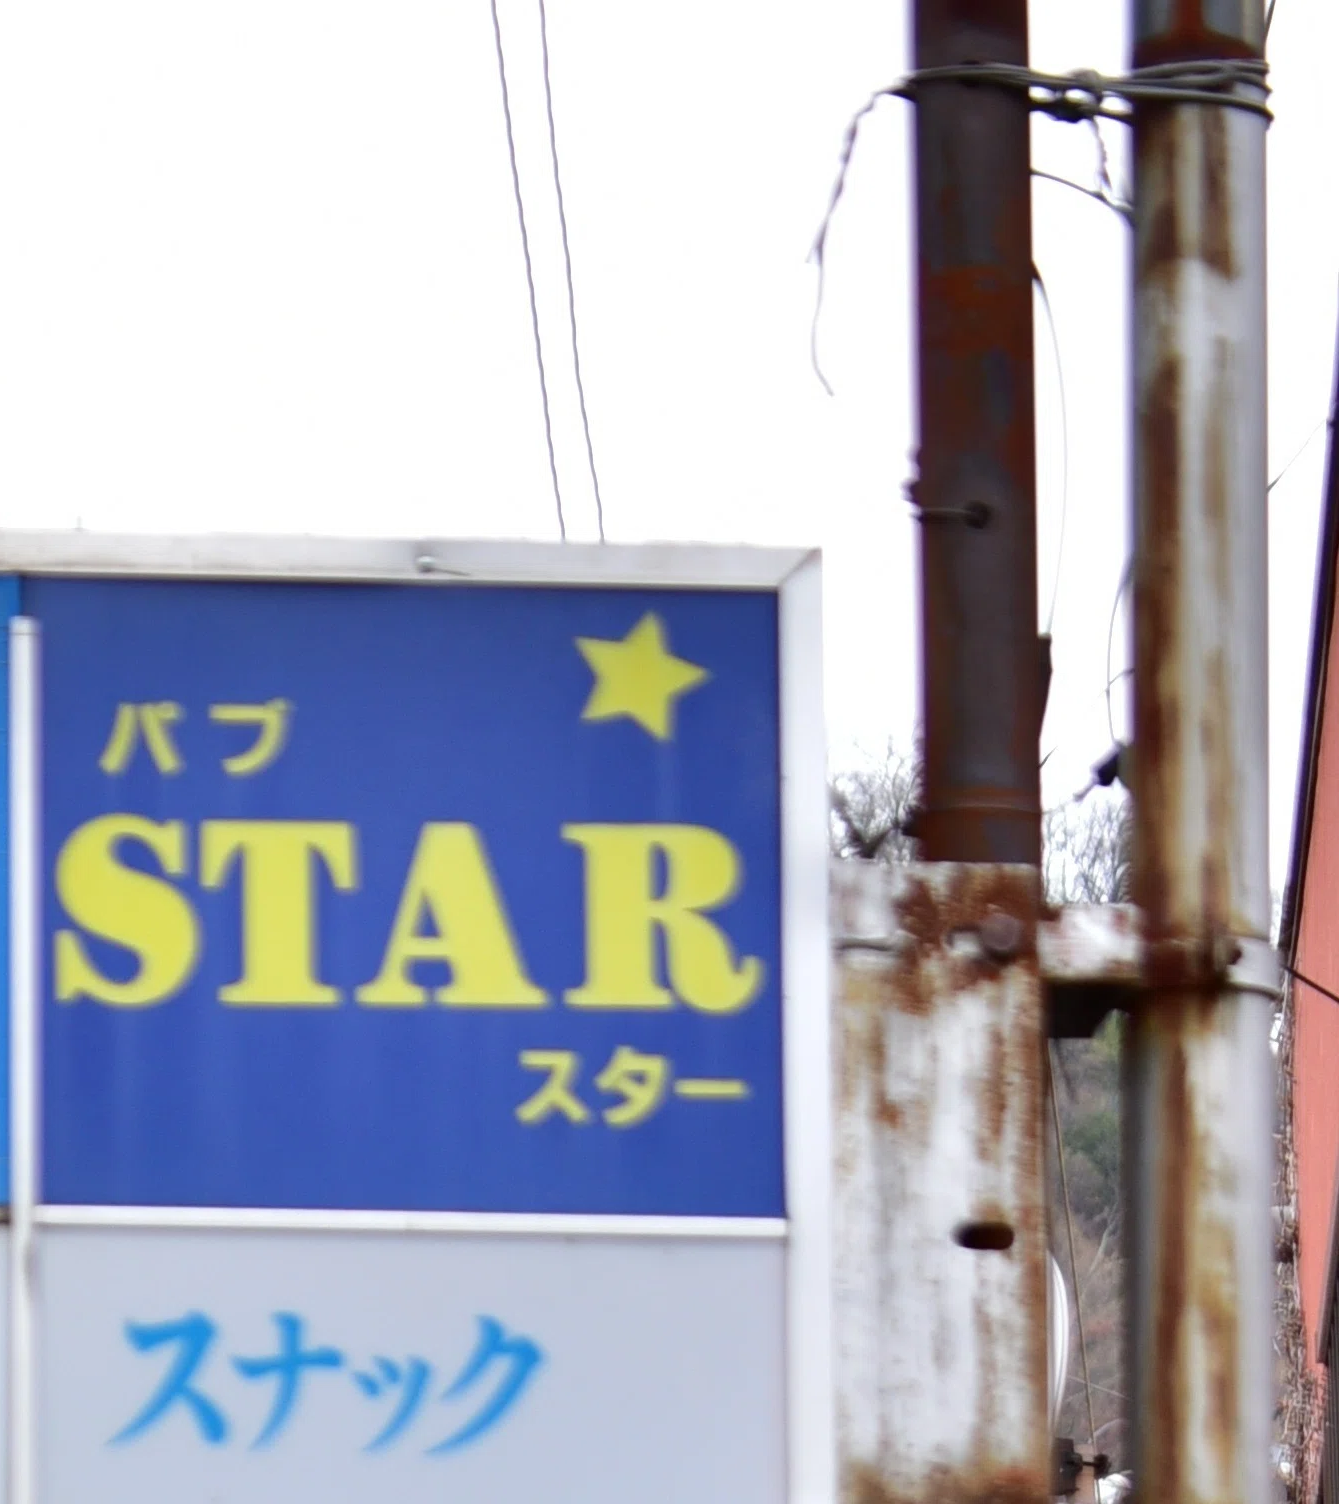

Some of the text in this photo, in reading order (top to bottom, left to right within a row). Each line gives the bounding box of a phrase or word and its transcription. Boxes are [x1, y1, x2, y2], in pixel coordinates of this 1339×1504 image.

[99, 699, 289, 777] パブ
[54, 812, 762, 1014] STAR
[515, 1046, 748, 1127] スター
[106, 1310, 549, 1457] スナック
